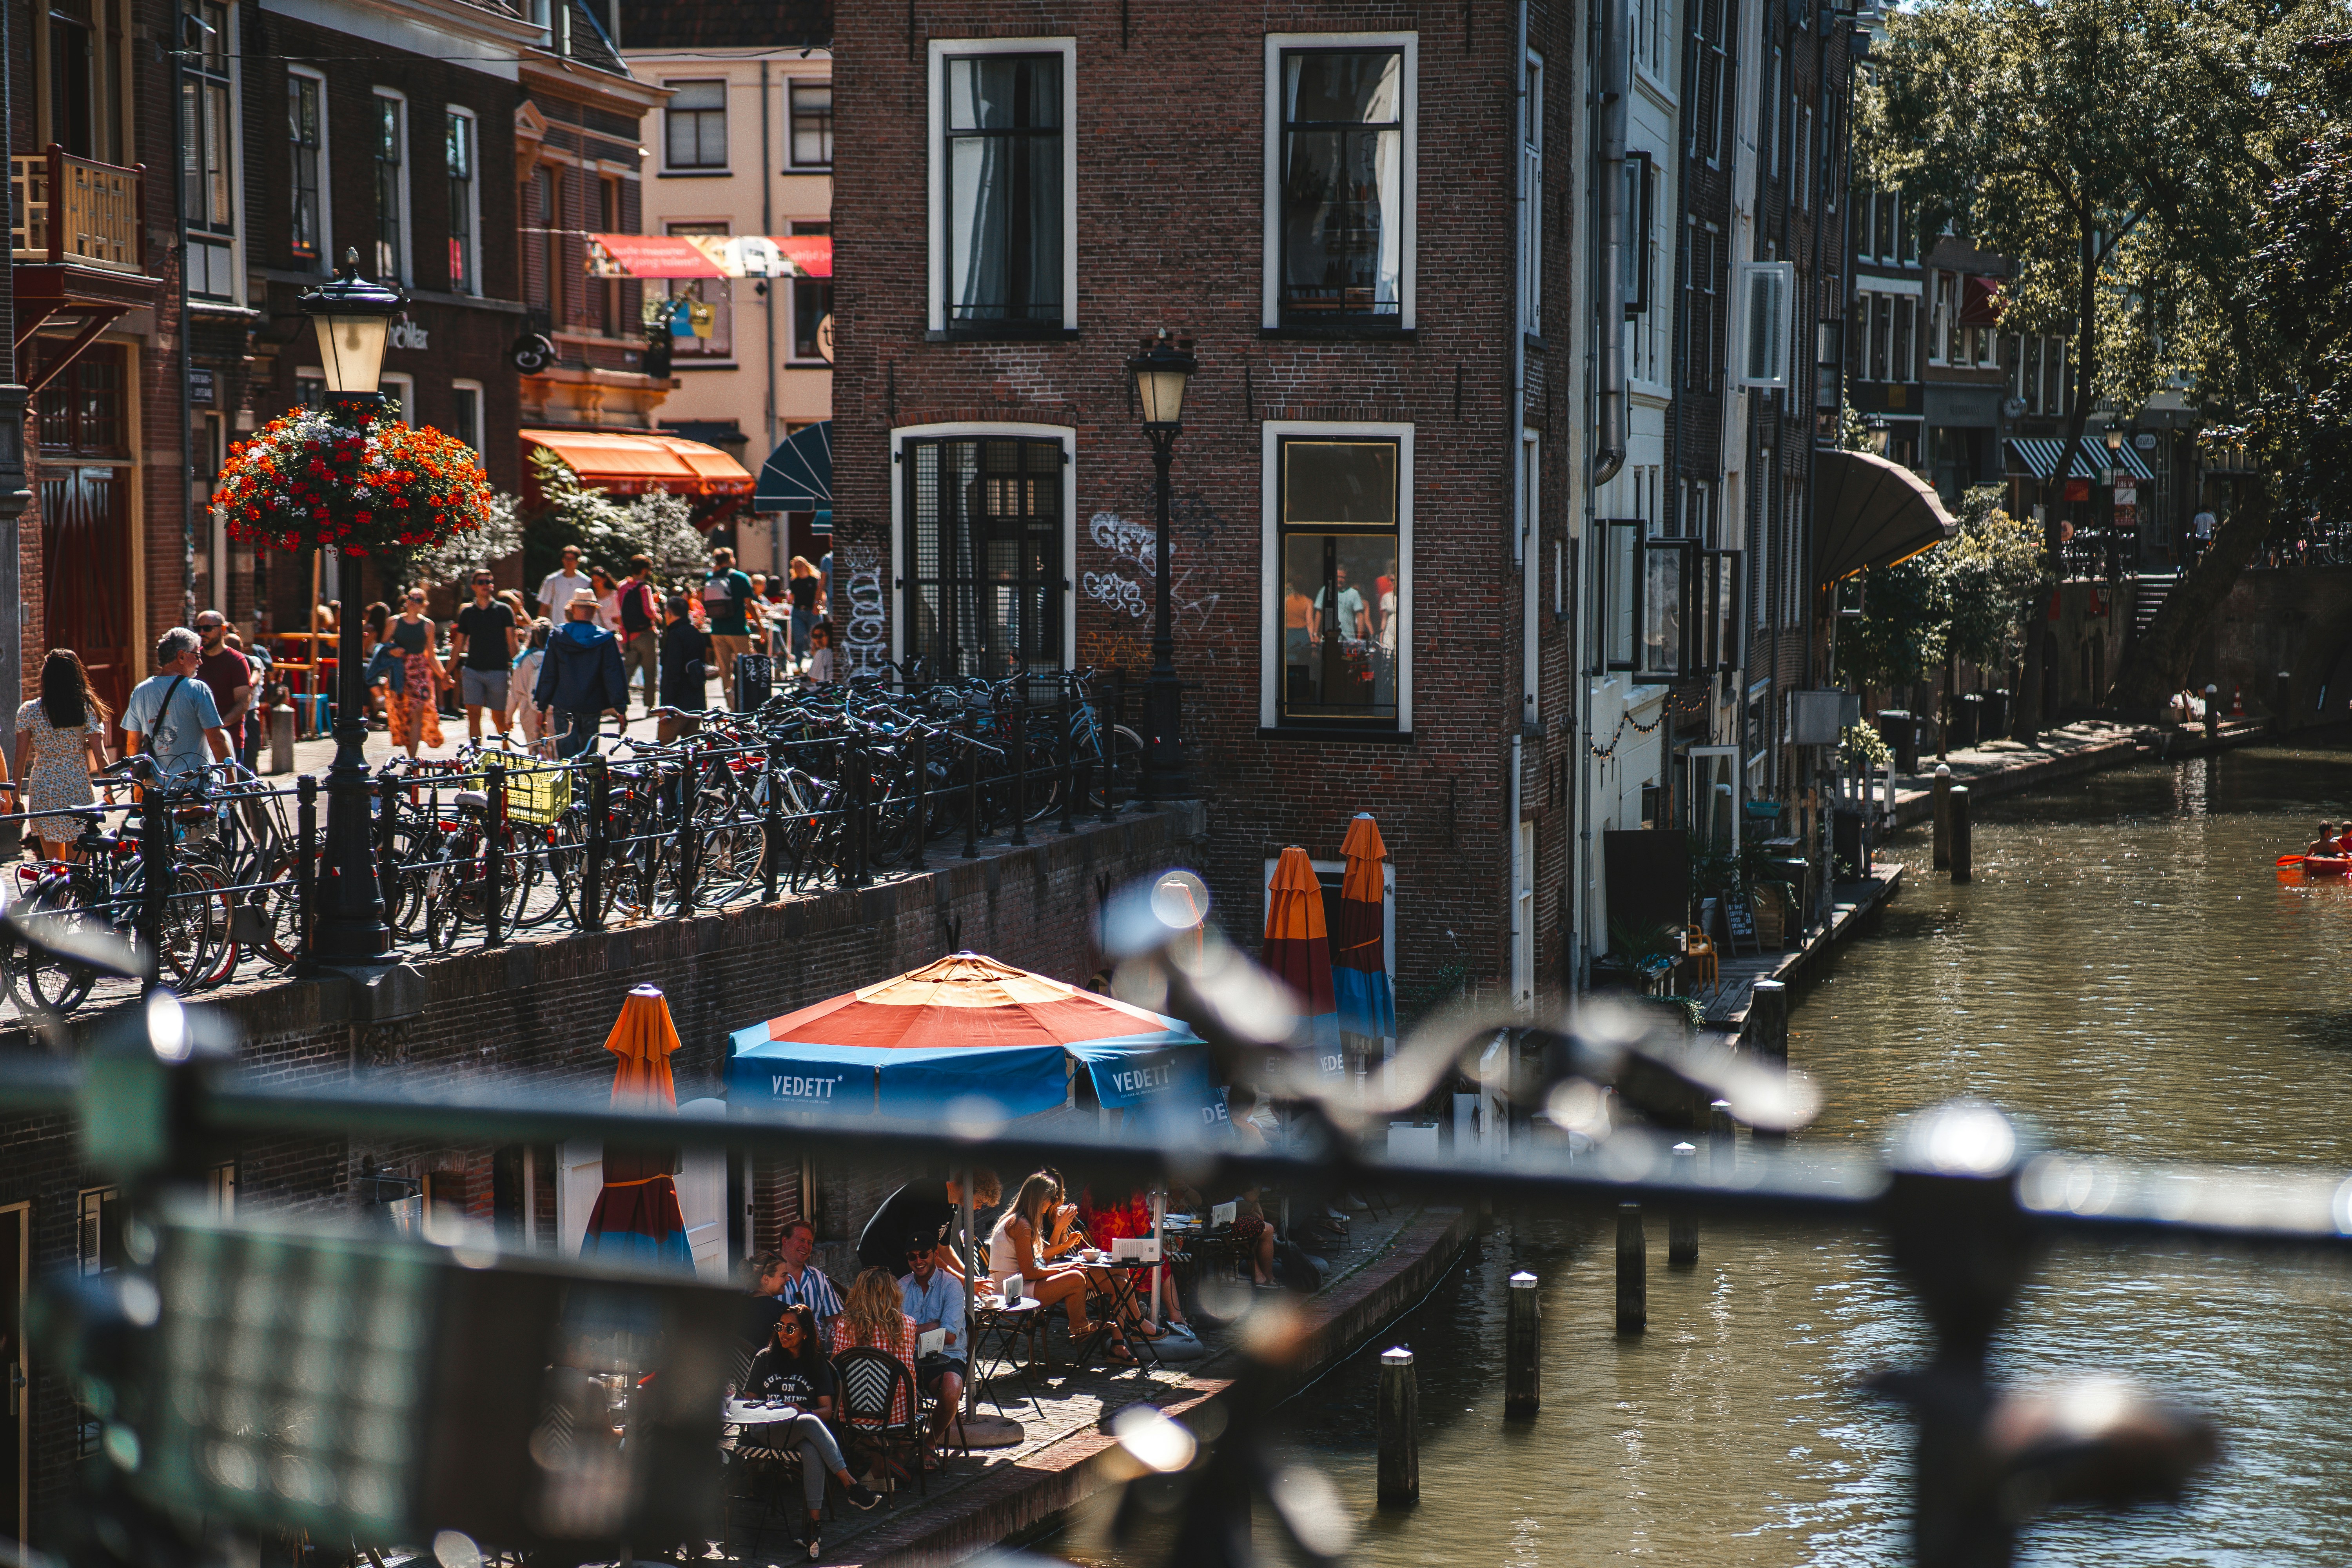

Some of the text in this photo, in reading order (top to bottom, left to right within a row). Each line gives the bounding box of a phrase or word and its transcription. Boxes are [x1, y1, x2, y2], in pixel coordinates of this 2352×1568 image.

[772, 1075, 835, 1098] VEDETT
[1112, 1064, 1170, 1093] VEDETT
[782, 1383, 795, 1392] ON
